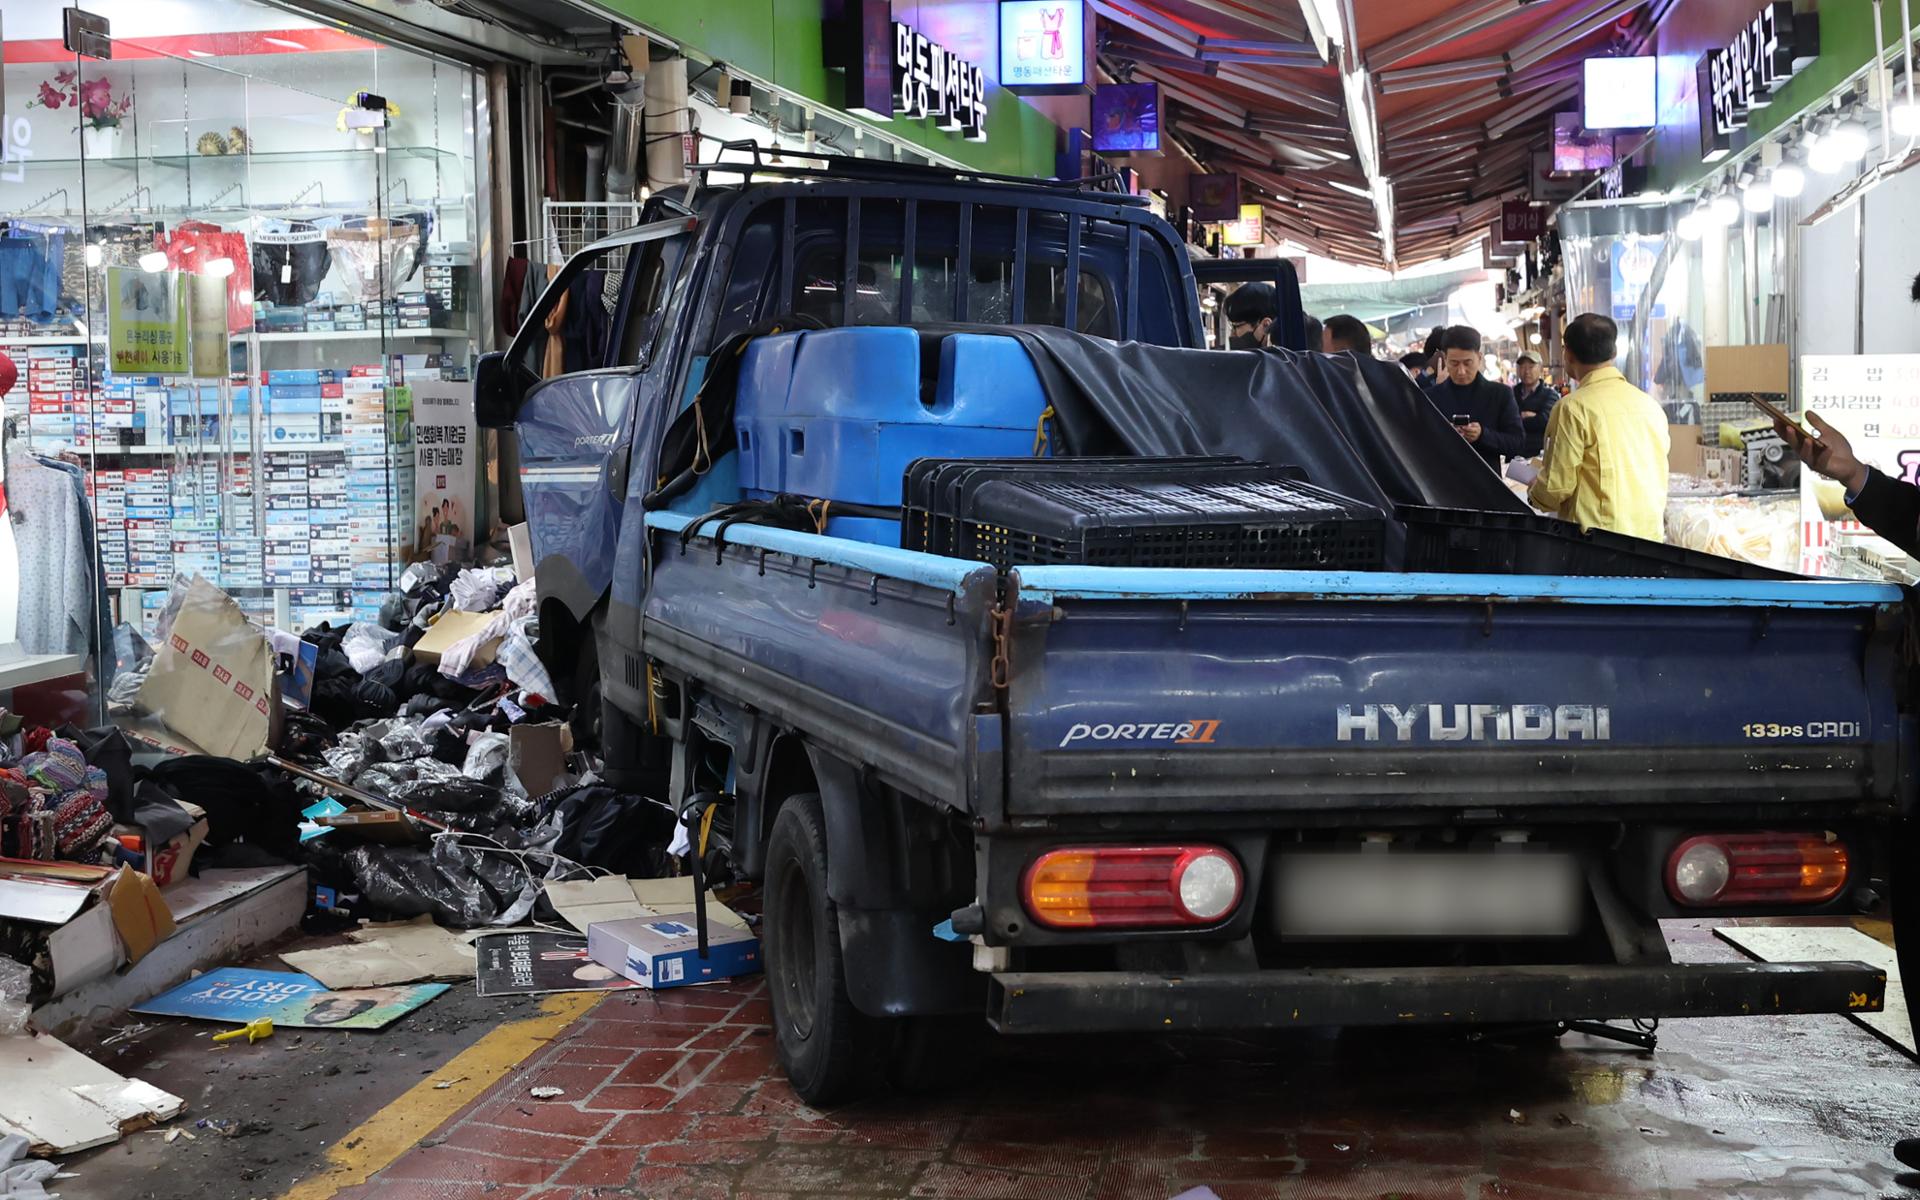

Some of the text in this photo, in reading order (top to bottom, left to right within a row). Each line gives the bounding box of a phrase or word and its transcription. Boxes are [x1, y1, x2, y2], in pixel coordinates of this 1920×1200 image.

[1012, 64, 1073, 78] 명동패션타운
[896, 22, 988, 142] 명동패션타운
[151, 350, 184, 366] 사용가능
[1811, 395, 1883, 410] 참치김밥
[416, 425, 467, 444] 민생회복 지원금
[192, 650, 210, 668] BYC
[214, 666, 231, 684] BYC
[1336, 703, 1611, 741] HYUNDAI
[1742, 721, 1861, 738] 133PS CRDi
[191, 987, 291, 1004] BODY
